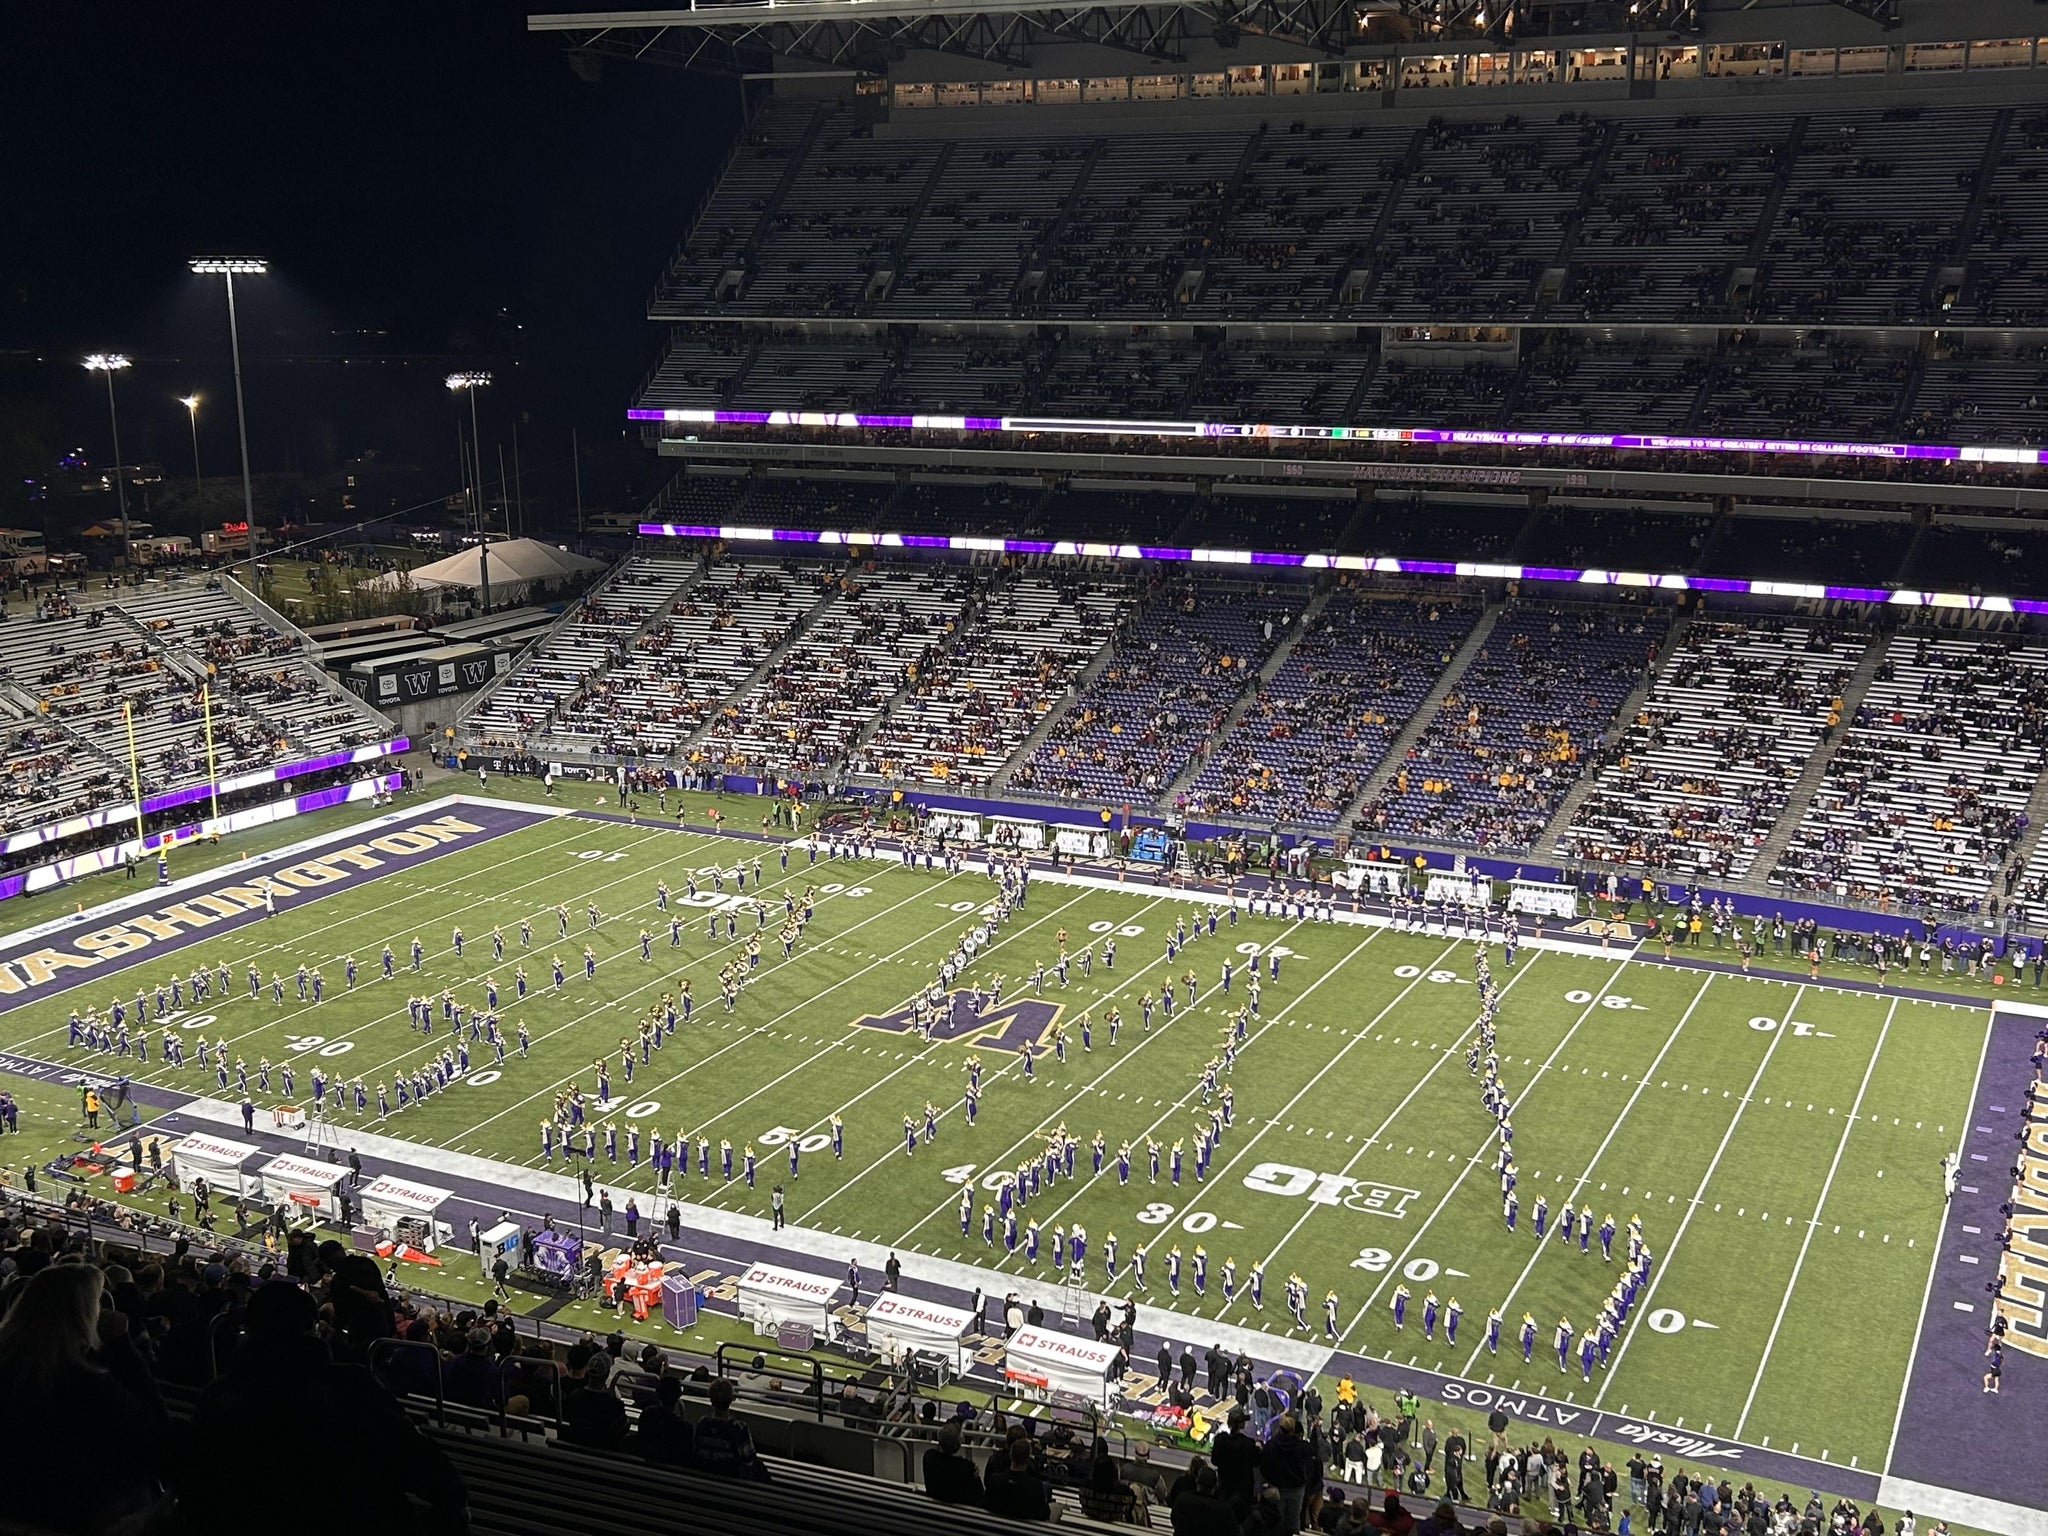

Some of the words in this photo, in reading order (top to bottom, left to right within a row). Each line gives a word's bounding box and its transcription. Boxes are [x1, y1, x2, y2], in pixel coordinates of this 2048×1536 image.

[1453, 432, 1505, 442] VOLLEYBALL
[1651, 439, 1691, 447] WELCOME
[1705, 440, 1721, 448] THE
[1722, 441, 1764, 449] GREATEST
[1765, 442, 1800, 451] SETTING
[1801, 443, 1810, 451] IN
[1811, 444, 1849, 452] COLLEGE
[1850, 445, 1895, 454] FOOTBALL
[1353, 466, 1430, 480] NATIONAL
[1430, 469, 1522, 484] CHAMPIONS
[1566, 474, 1588, 485] 1991
[462, 660, 488, 685] W
[404, 671, 431, 696] W
[437, 685, 459, 694] TOYOTA
[378, 698, 401, 706] TOYOTA
[1748, 1016, 1816, 1036] 10
[286, 1036, 355, 1057] 20
[758, 1125, 833, 1152] 50
[197, 1142, 246, 1159] STRAUSS
[286, 1163, 338, 1181] STRAUSS
[388, 1186, 440, 1205] STRAUSS
[1136, 1202, 1218, 1234] 30
[1350, 1247, 1440, 1281] 20
[767, 1275, 830, 1296] STRAUSS
[896, 1306, 962, 1329] STRAUSS
[1037, 1339, 1108, 1363] STRAUSS
[1441, 1382, 1581, 1426] ATMOS
[1615, 1422, 1744, 1459] Alaska
